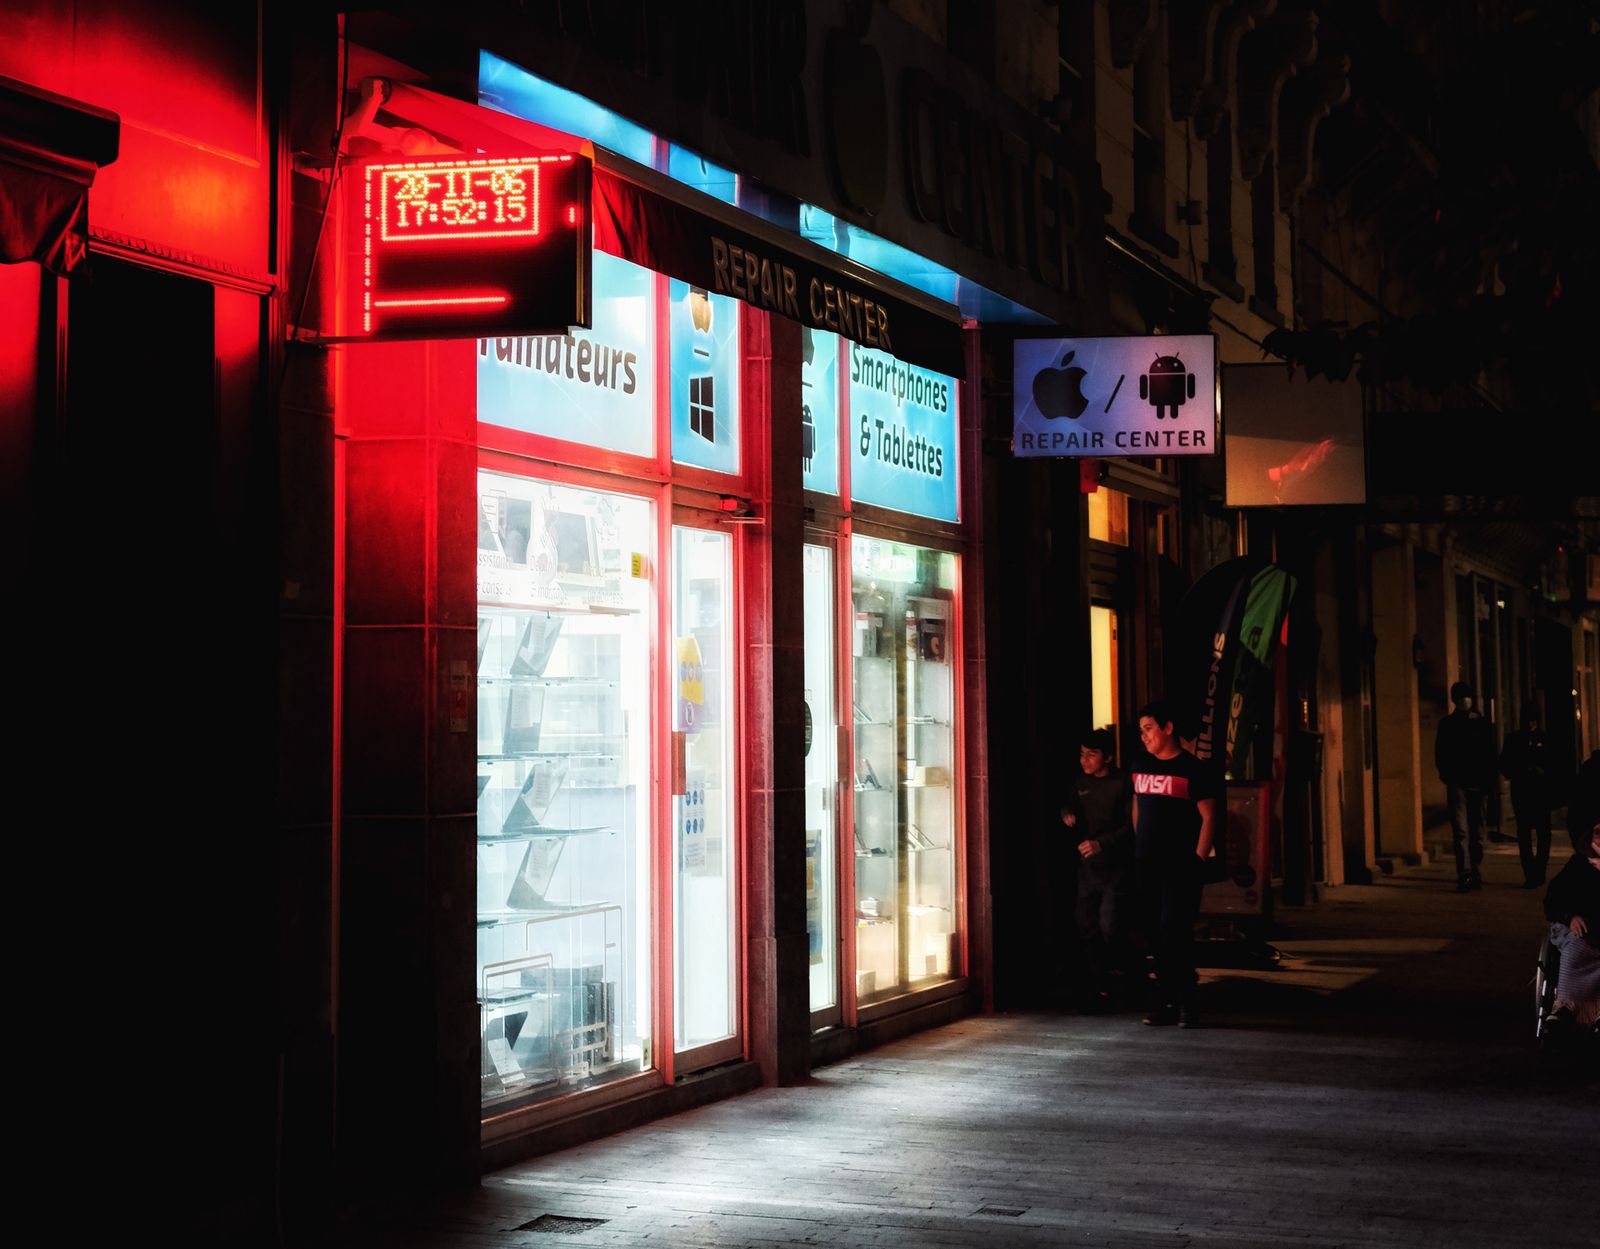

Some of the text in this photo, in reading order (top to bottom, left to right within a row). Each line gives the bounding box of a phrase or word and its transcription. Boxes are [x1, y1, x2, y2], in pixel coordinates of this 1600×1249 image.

[394, 166, 526, 200] 20-11-06
[397, 196, 526, 227] 17:52:15
[711, 236, 893, 351] REPAIR CENTER
[480, 336, 636, 394] inateurs
[852, 342, 947, 413] Smartphones
[860, 414, 943, 477] & Tablettes
[1022, 430, 1206, 449] REPAIR CENTER
[1134, 774, 1172, 795] NASA
